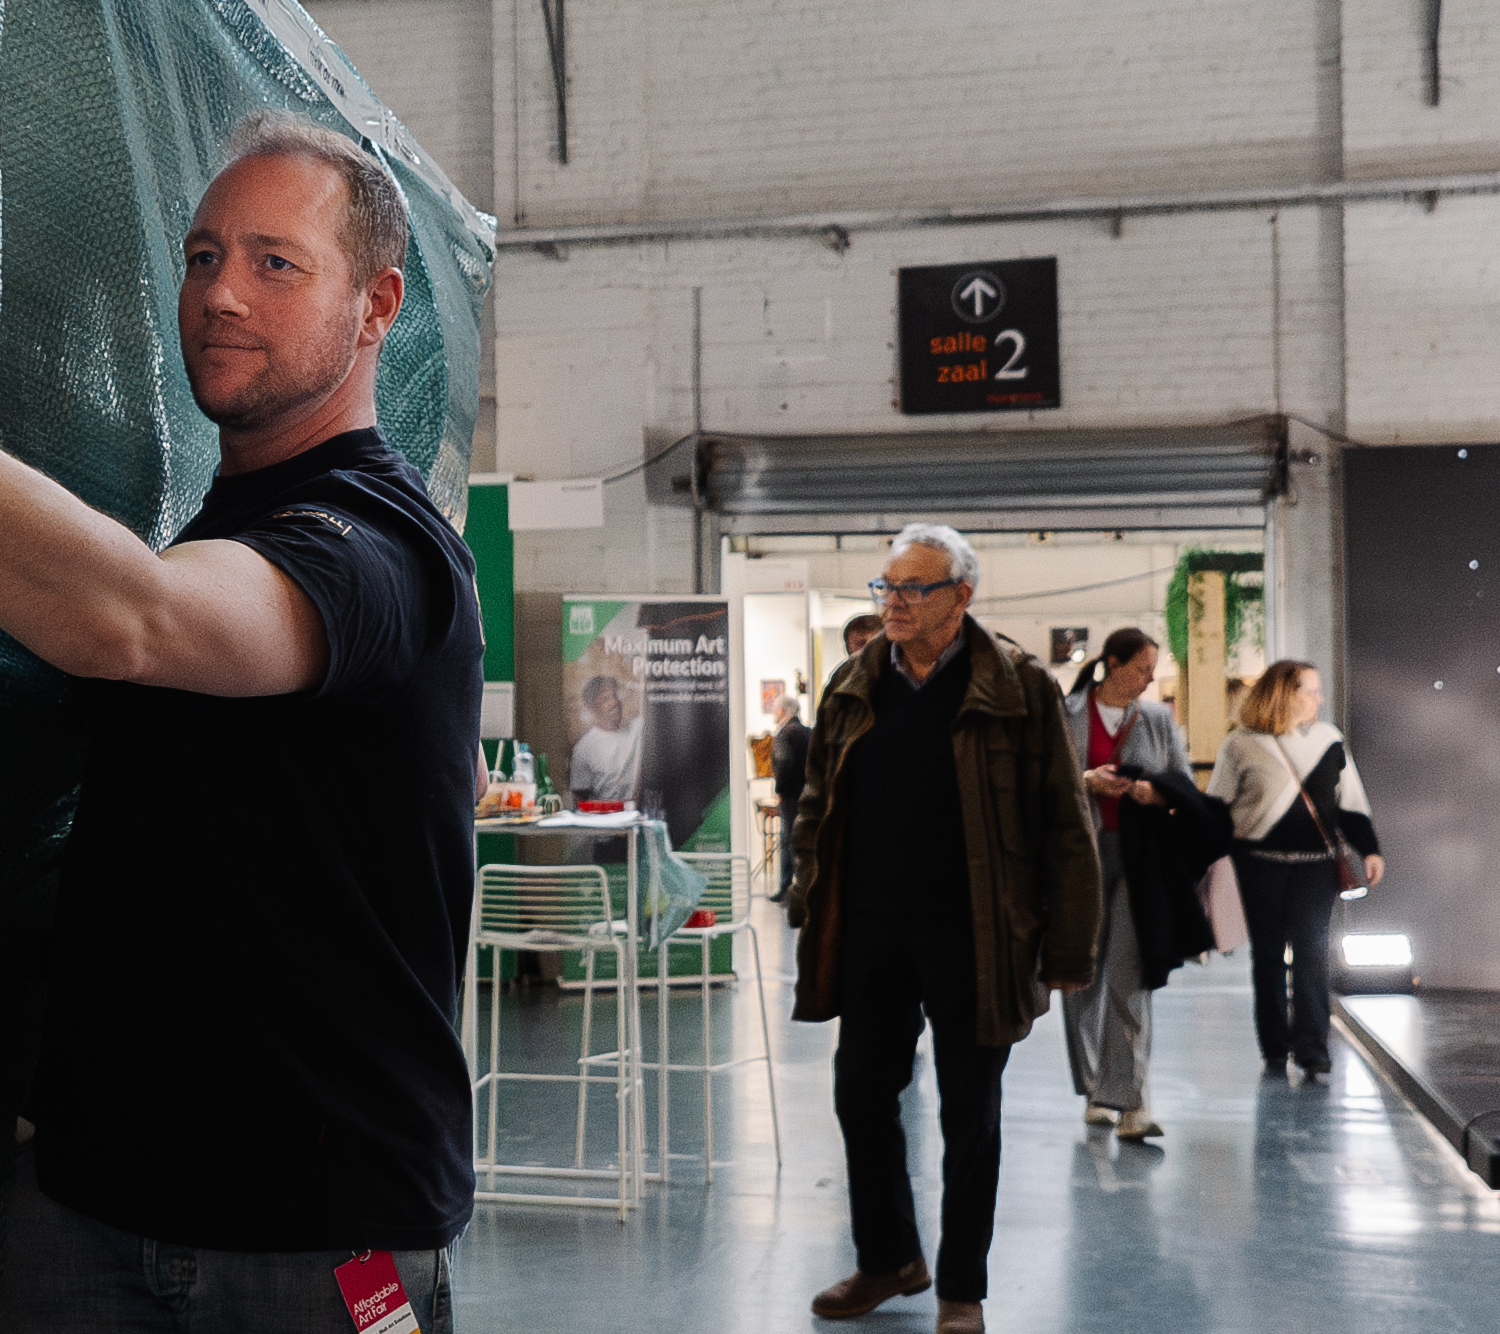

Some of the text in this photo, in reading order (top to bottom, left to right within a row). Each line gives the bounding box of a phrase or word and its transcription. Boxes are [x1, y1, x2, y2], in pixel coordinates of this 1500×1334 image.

[929, 332, 987, 355] salle
[994, 329, 1028, 380] 2
[937, 360, 988, 383] zaal
[604, 634, 726, 655] Maximum Art
[632, 657, 725, 677] Protection
[353, 1281, 399, 1316] Affordable
[358, 1301, 387, 1327] Art Fair
